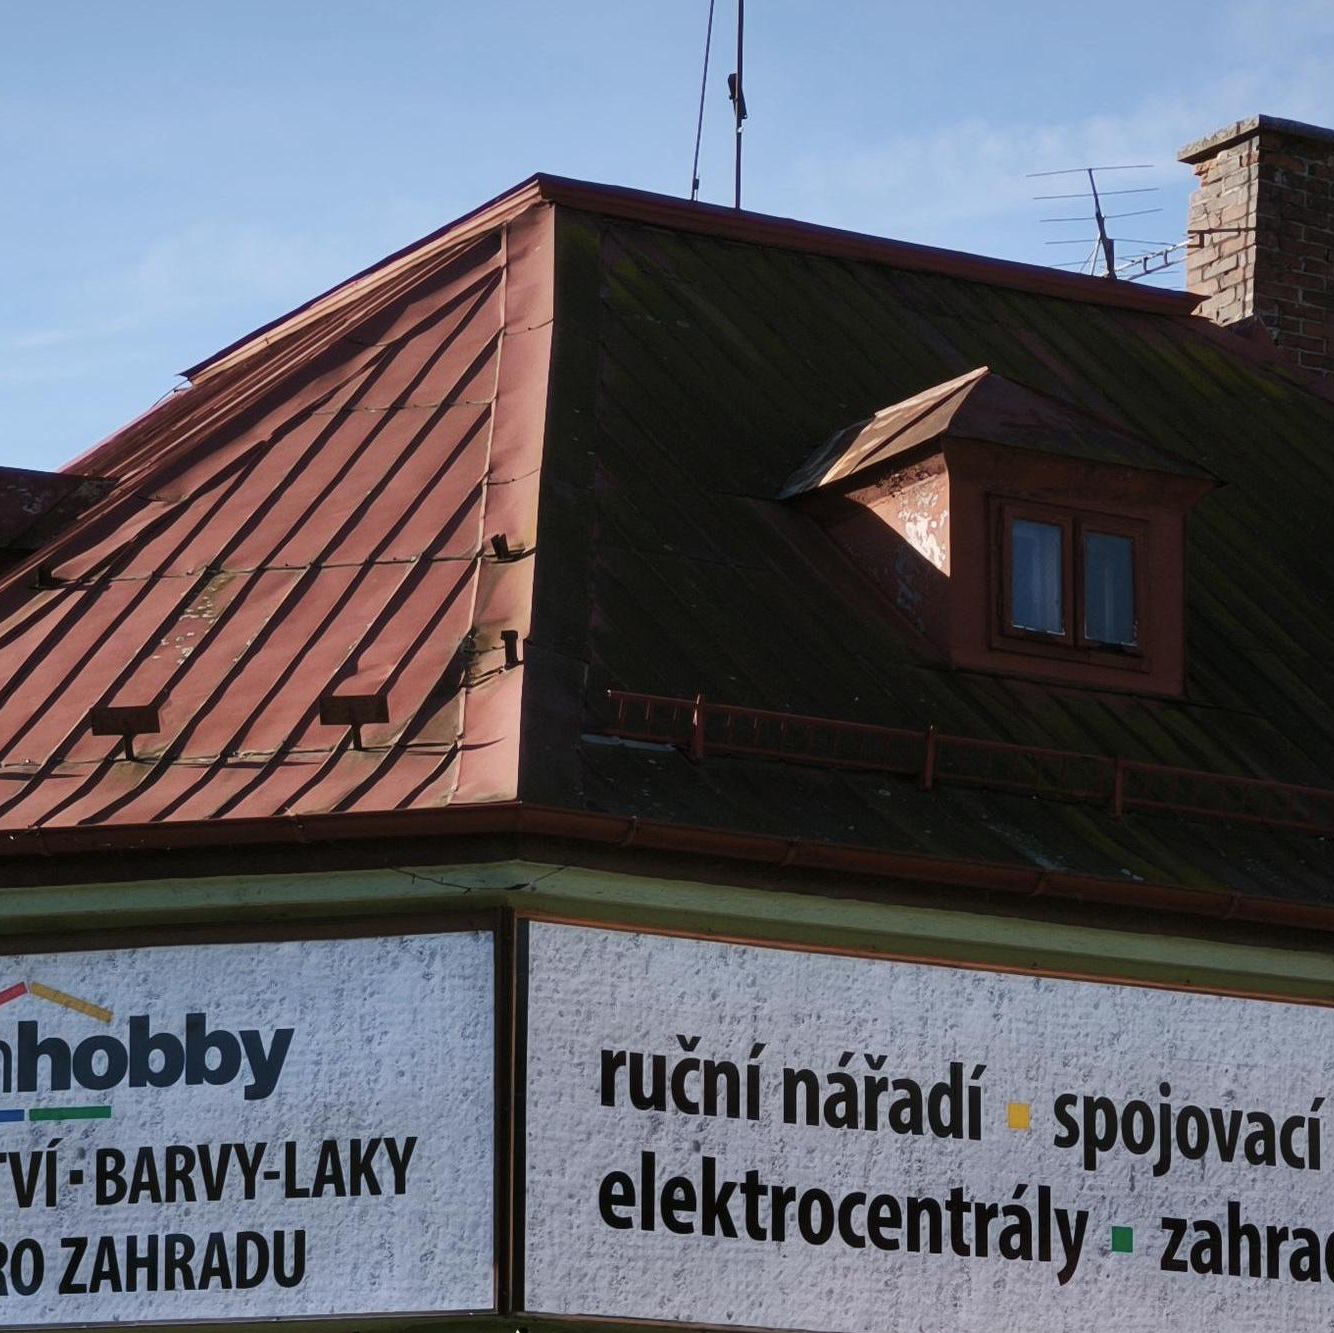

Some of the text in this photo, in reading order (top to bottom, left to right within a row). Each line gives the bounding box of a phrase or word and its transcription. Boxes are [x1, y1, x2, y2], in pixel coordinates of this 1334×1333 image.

[600, 1034, 766, 1120] ruční
[782, 1051, 987, 1140] nářadí
[1053, 1081, 1325, 1177] spojovací
[95, 1136, 418, 1205] BARVY-LAKY
[598, 1151, 1089, 1287] elektrocentrály
[61, 1229, 307, 1295] ZAHRADU
